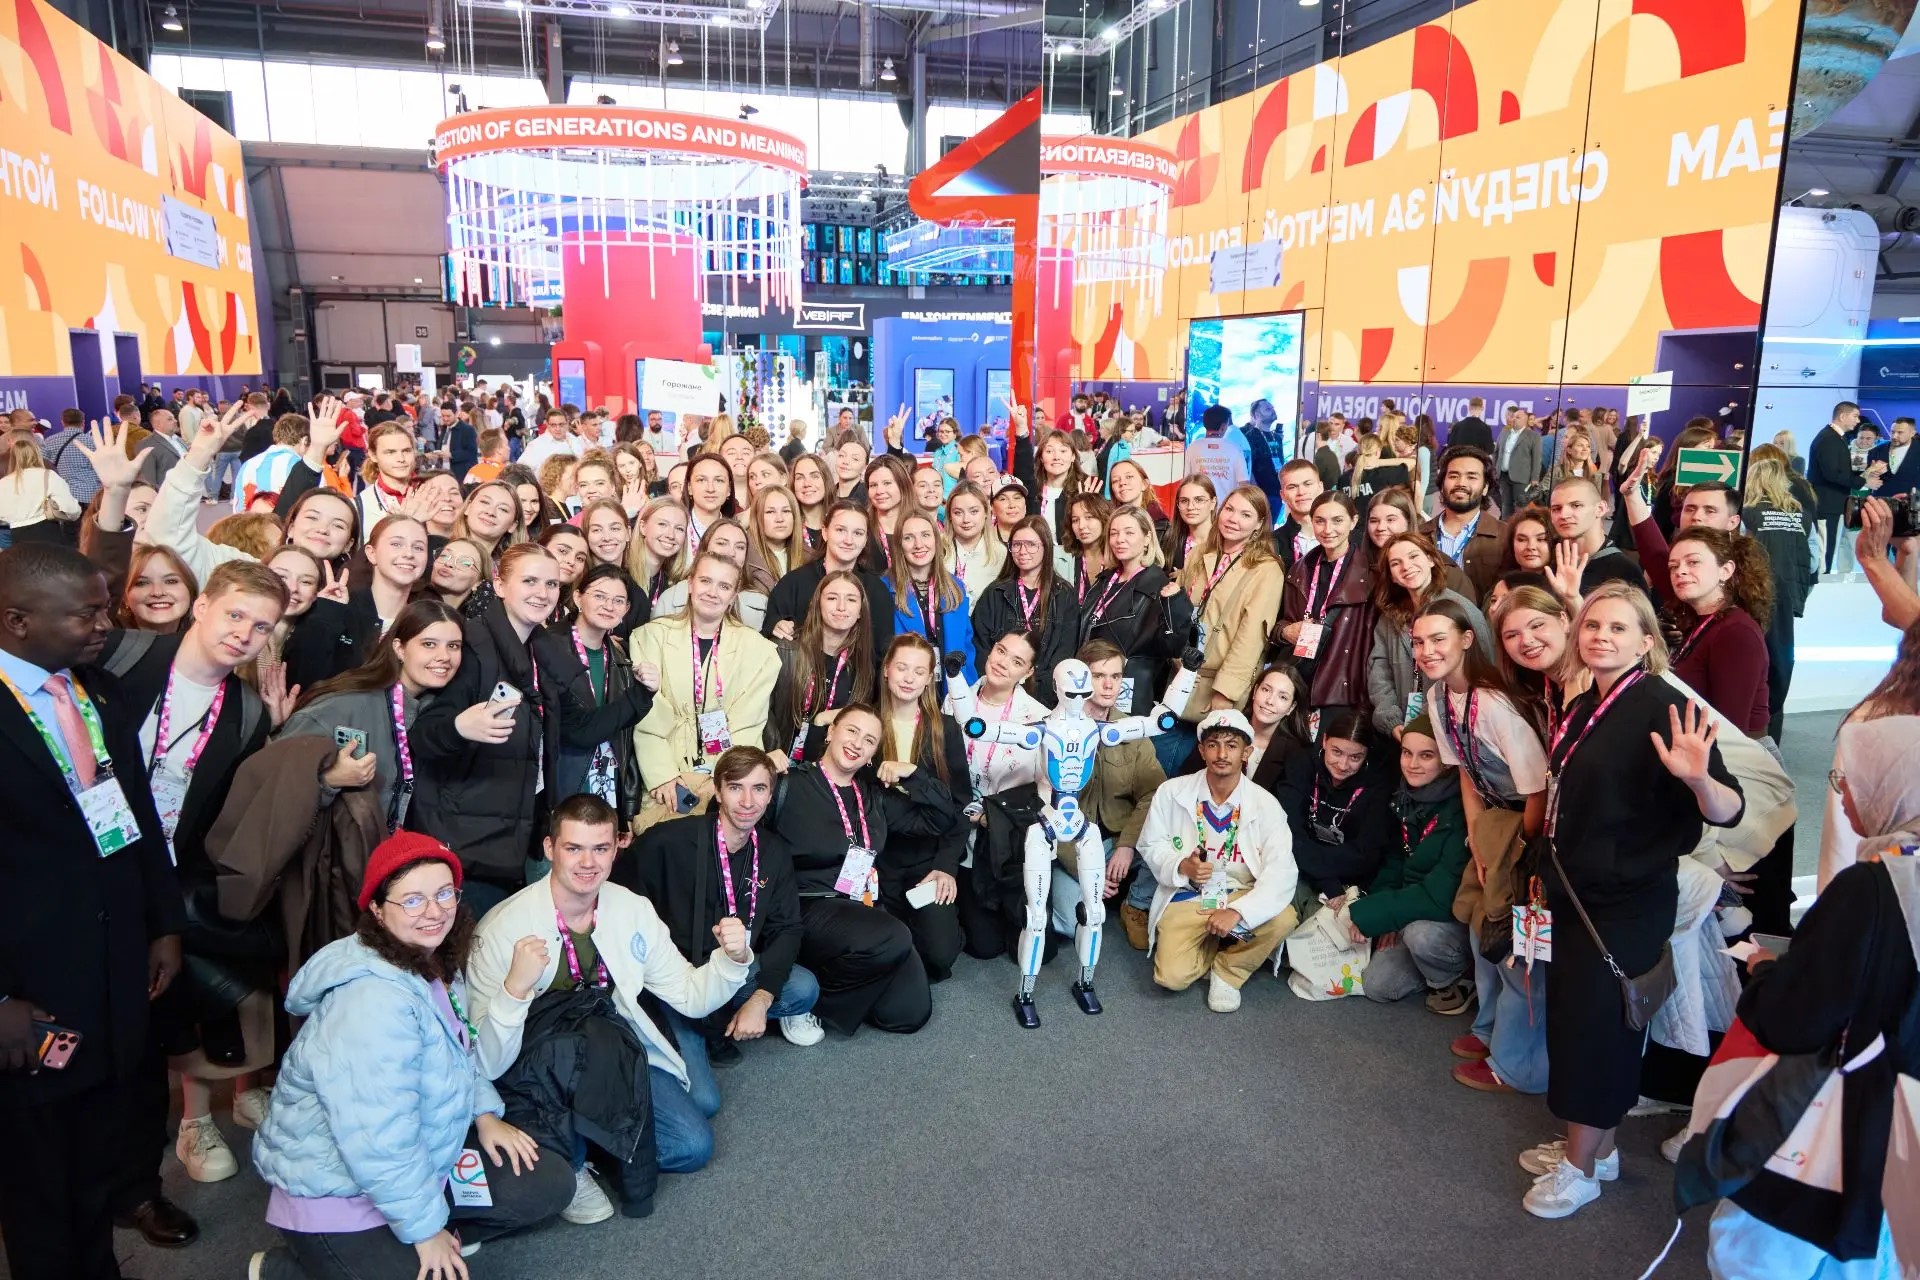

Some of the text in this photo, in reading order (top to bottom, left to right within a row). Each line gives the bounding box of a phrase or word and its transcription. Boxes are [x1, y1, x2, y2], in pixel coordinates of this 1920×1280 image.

[436, 124, 482, 150] ECTION
[484, 119, 511, 140] OF
[514, 117, 688, 142] GENERATIONS
[691, 125, 737, 147] AND
[77, 179, 149, 240] FOLLOW
[416, 327, 428, 338] 35
[1066, 742, 1080, 753] 01
